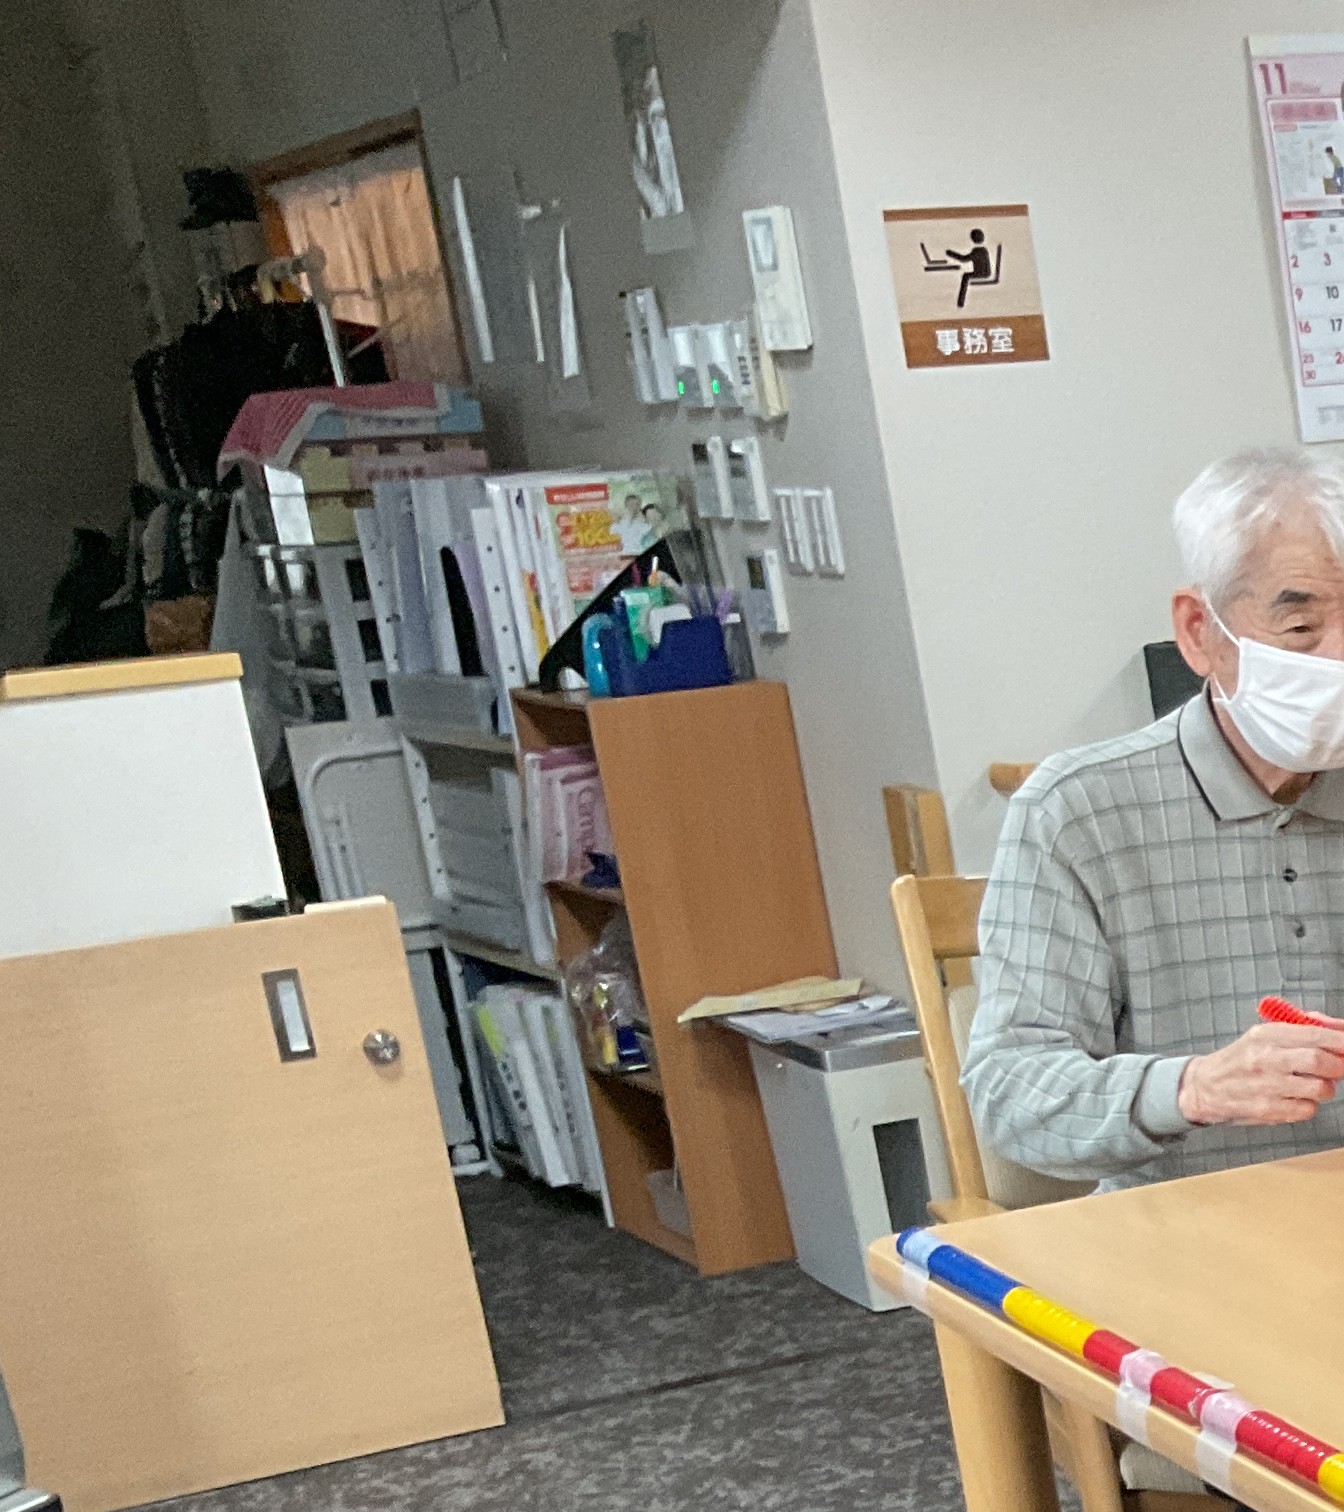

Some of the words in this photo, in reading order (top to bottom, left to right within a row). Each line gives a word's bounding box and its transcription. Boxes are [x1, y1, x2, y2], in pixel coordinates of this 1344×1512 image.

[1259, 63, 1287, 94] 11
[1291, 254, 1299, 268] 2
[1323, 252, 1331, 266] 3
[1295, 287, 1303, 301] 9
[1326, 285, 1339, 299] 10
[1298, 320, 1311, 334] 16
[1330, 318, 1342, 332] 17
[935, 326, 1015, 356] 事務室
